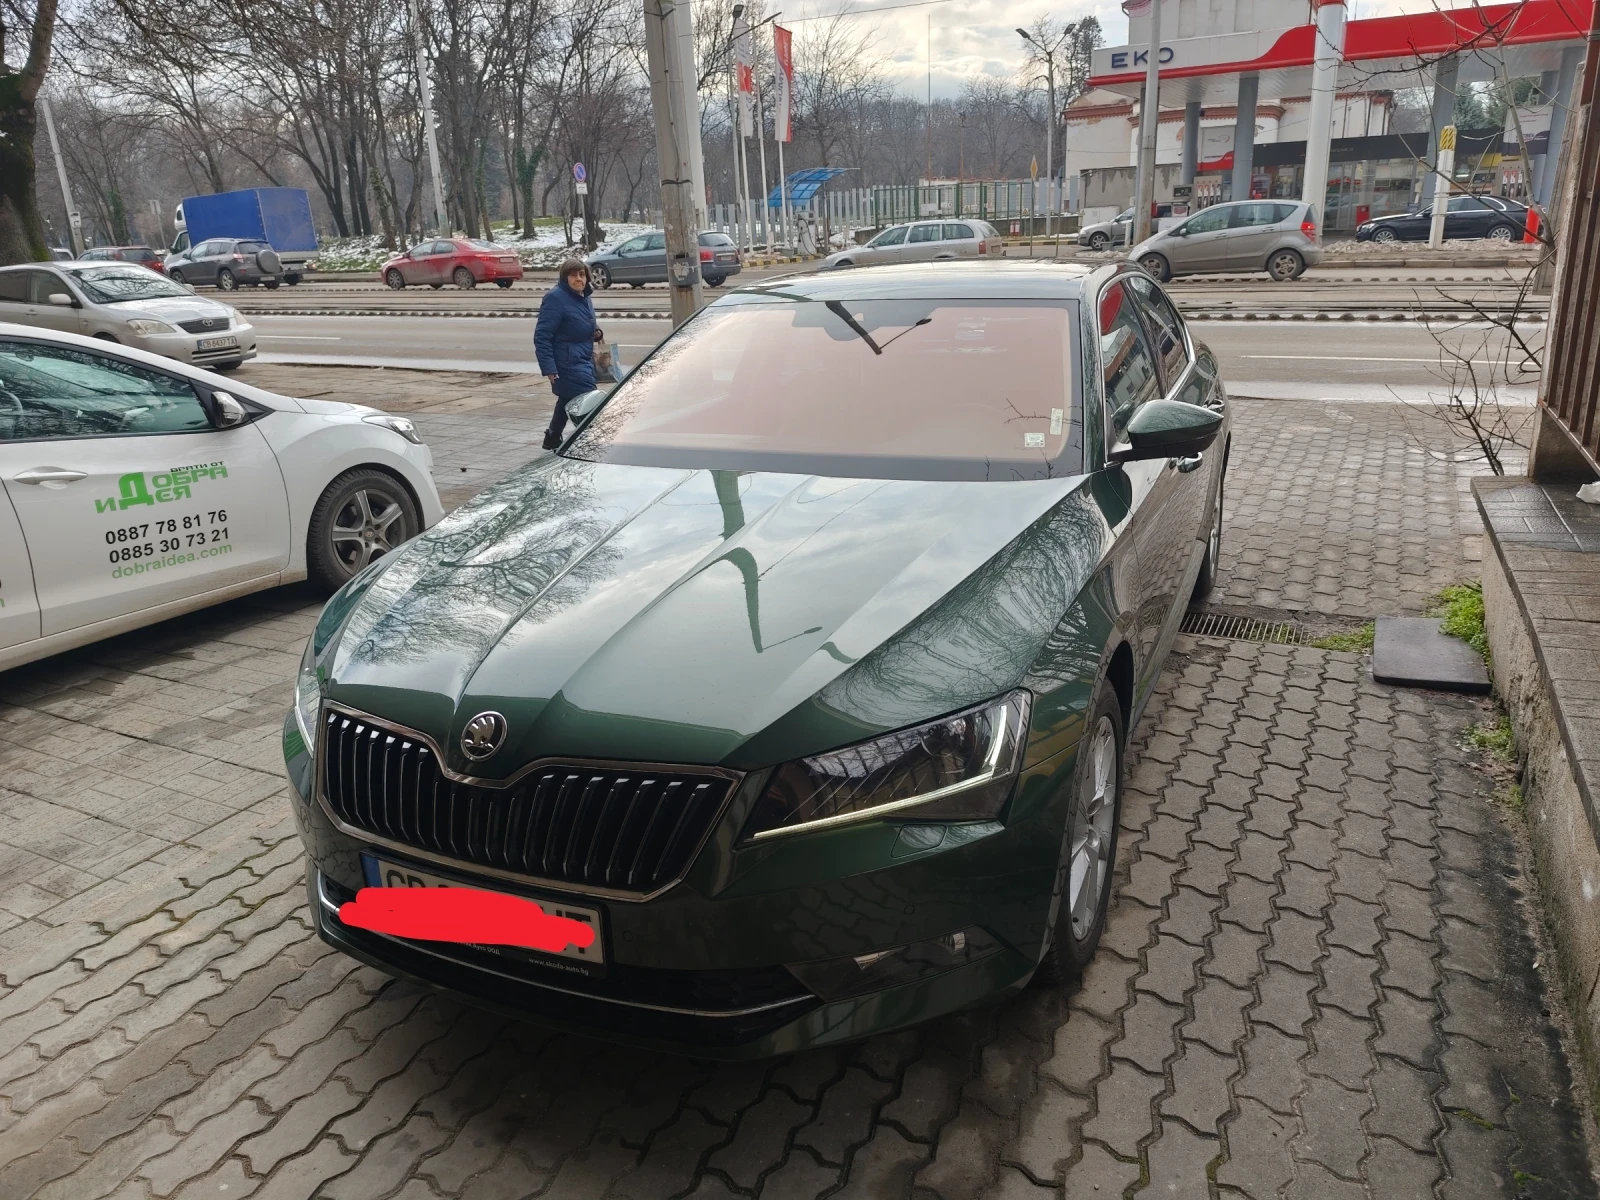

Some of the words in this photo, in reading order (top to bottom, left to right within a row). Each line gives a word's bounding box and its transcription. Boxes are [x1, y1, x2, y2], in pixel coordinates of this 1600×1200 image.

[1111, 47, 1174, 68] EKO
[105, 524, 149, 544] 0887
[155, 519, 177, 535] 78
[182, 514, 201, 529] 81
[207, 509, 228, 524] 76
[109, 543, 154, 563] 0885
[159, 537, 180, 552] 30
[185, 532, 206, 547] 73
[211, 527, 229, 542] 21
[111, 544, 232, 579] dobraidea.com
[528, 957, 589, 976] www.skoda-auto.bg
